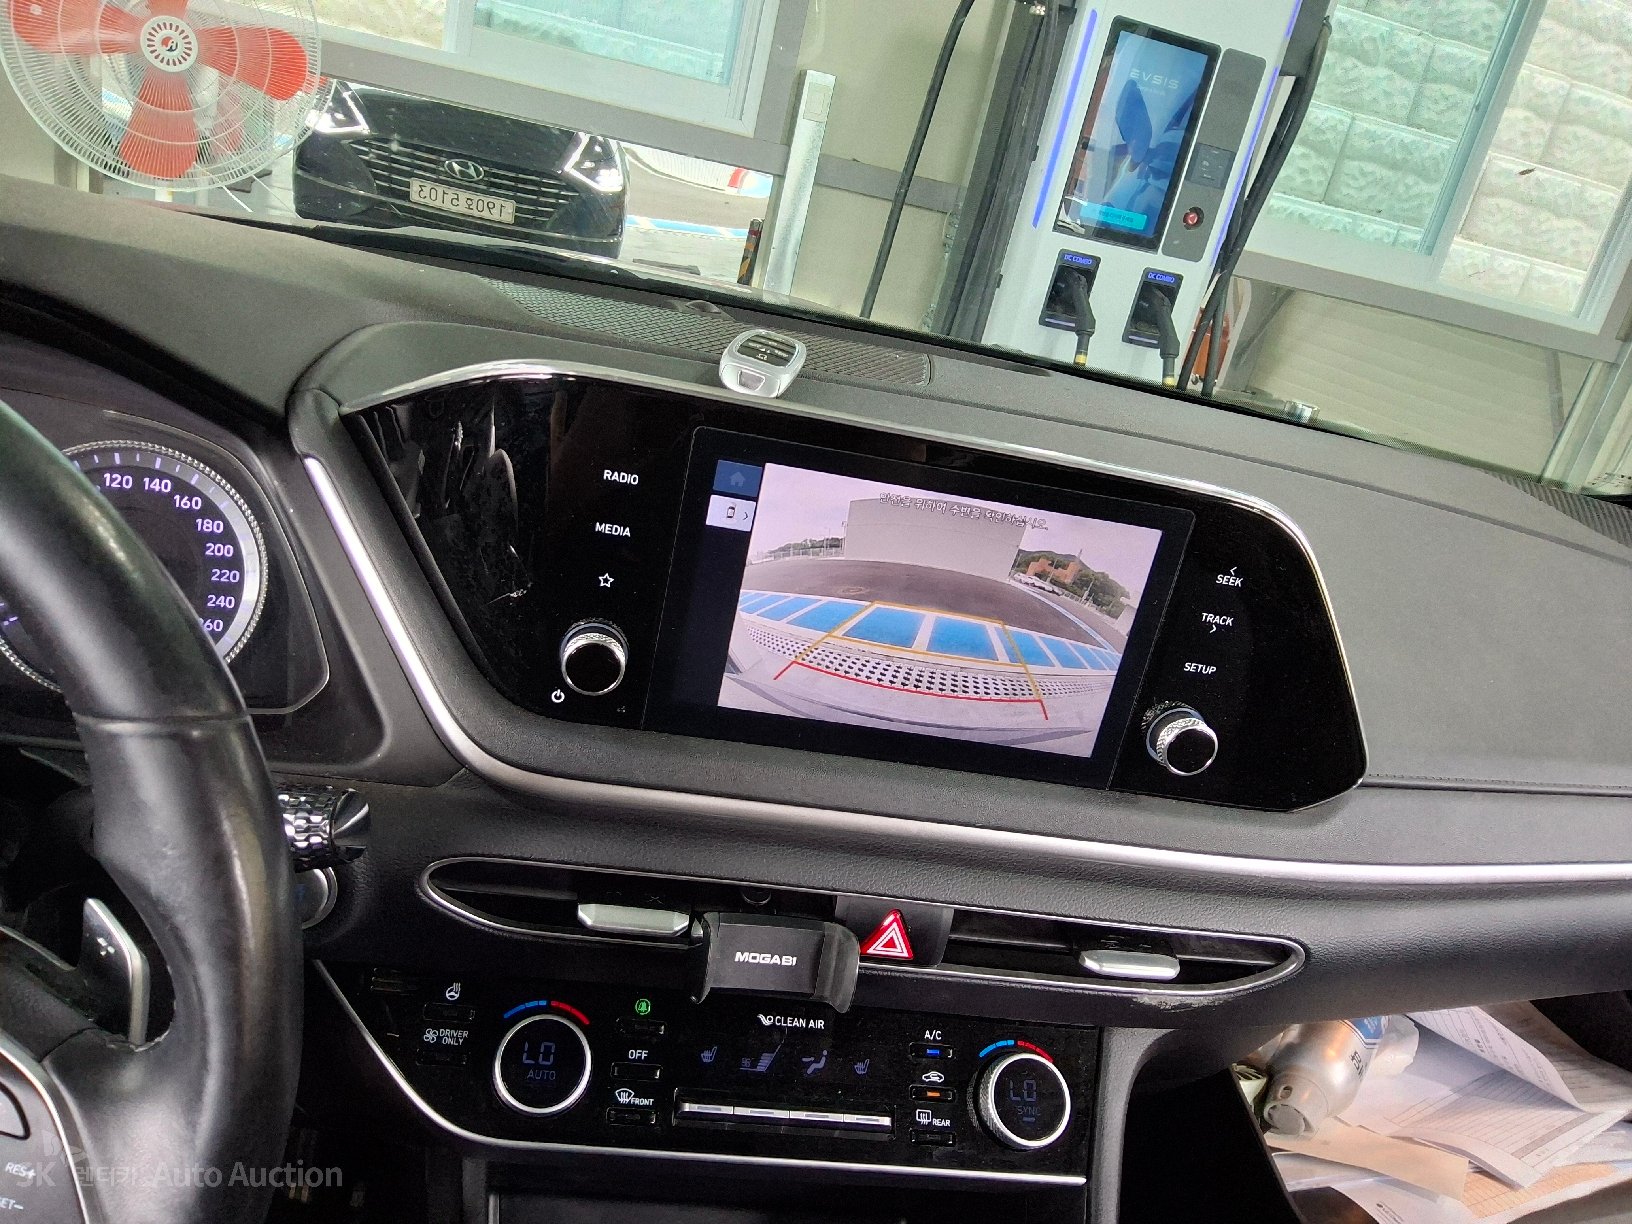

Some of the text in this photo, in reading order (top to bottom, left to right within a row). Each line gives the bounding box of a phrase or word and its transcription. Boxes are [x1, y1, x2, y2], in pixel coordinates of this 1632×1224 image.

[1129, 67, 1180, 90] EVSIS
[103, 473, 133, 489] 120
[603, 469, 639, 485] RADIO
[143, 477, 172, 493] 140
[173, 494, 202, 510] 160
[880, 492, 911, 508] 안전을
[915, 498, 947, 514] 위하여
[195, 518, 224, 534] 180
[595, 521, 631, 537] MEDIA
[205, 543, 234, 557] 200
[211, 568, 240, 583] 220
[1216, 574, 1243, 587] SEEK
[207, 594, 236, 609] 240
[1201, 612, 1234, 626] TRACK
[1183, 662, 1217, 675] SETUP
[734, 951, 797, 966] MOGABI
[774, 1016, 825, 1030] CLEAN AIR
[439, 1029, 469, 1040] DRIVER
[441, 1036, 464, 1046] ONLY
[924, 1030, 942, 1041] A/C
[628, 1049, 649, 1060] OFF
[526, 1069, 556, 1080] AUTO
[630, 1097, 655, 1106] FRONT
[1016, 1105, 1041, 1115] SYNC
[932, 1117, 951, 1127] REAR
[5, 1161, 36, 1179] RES+
